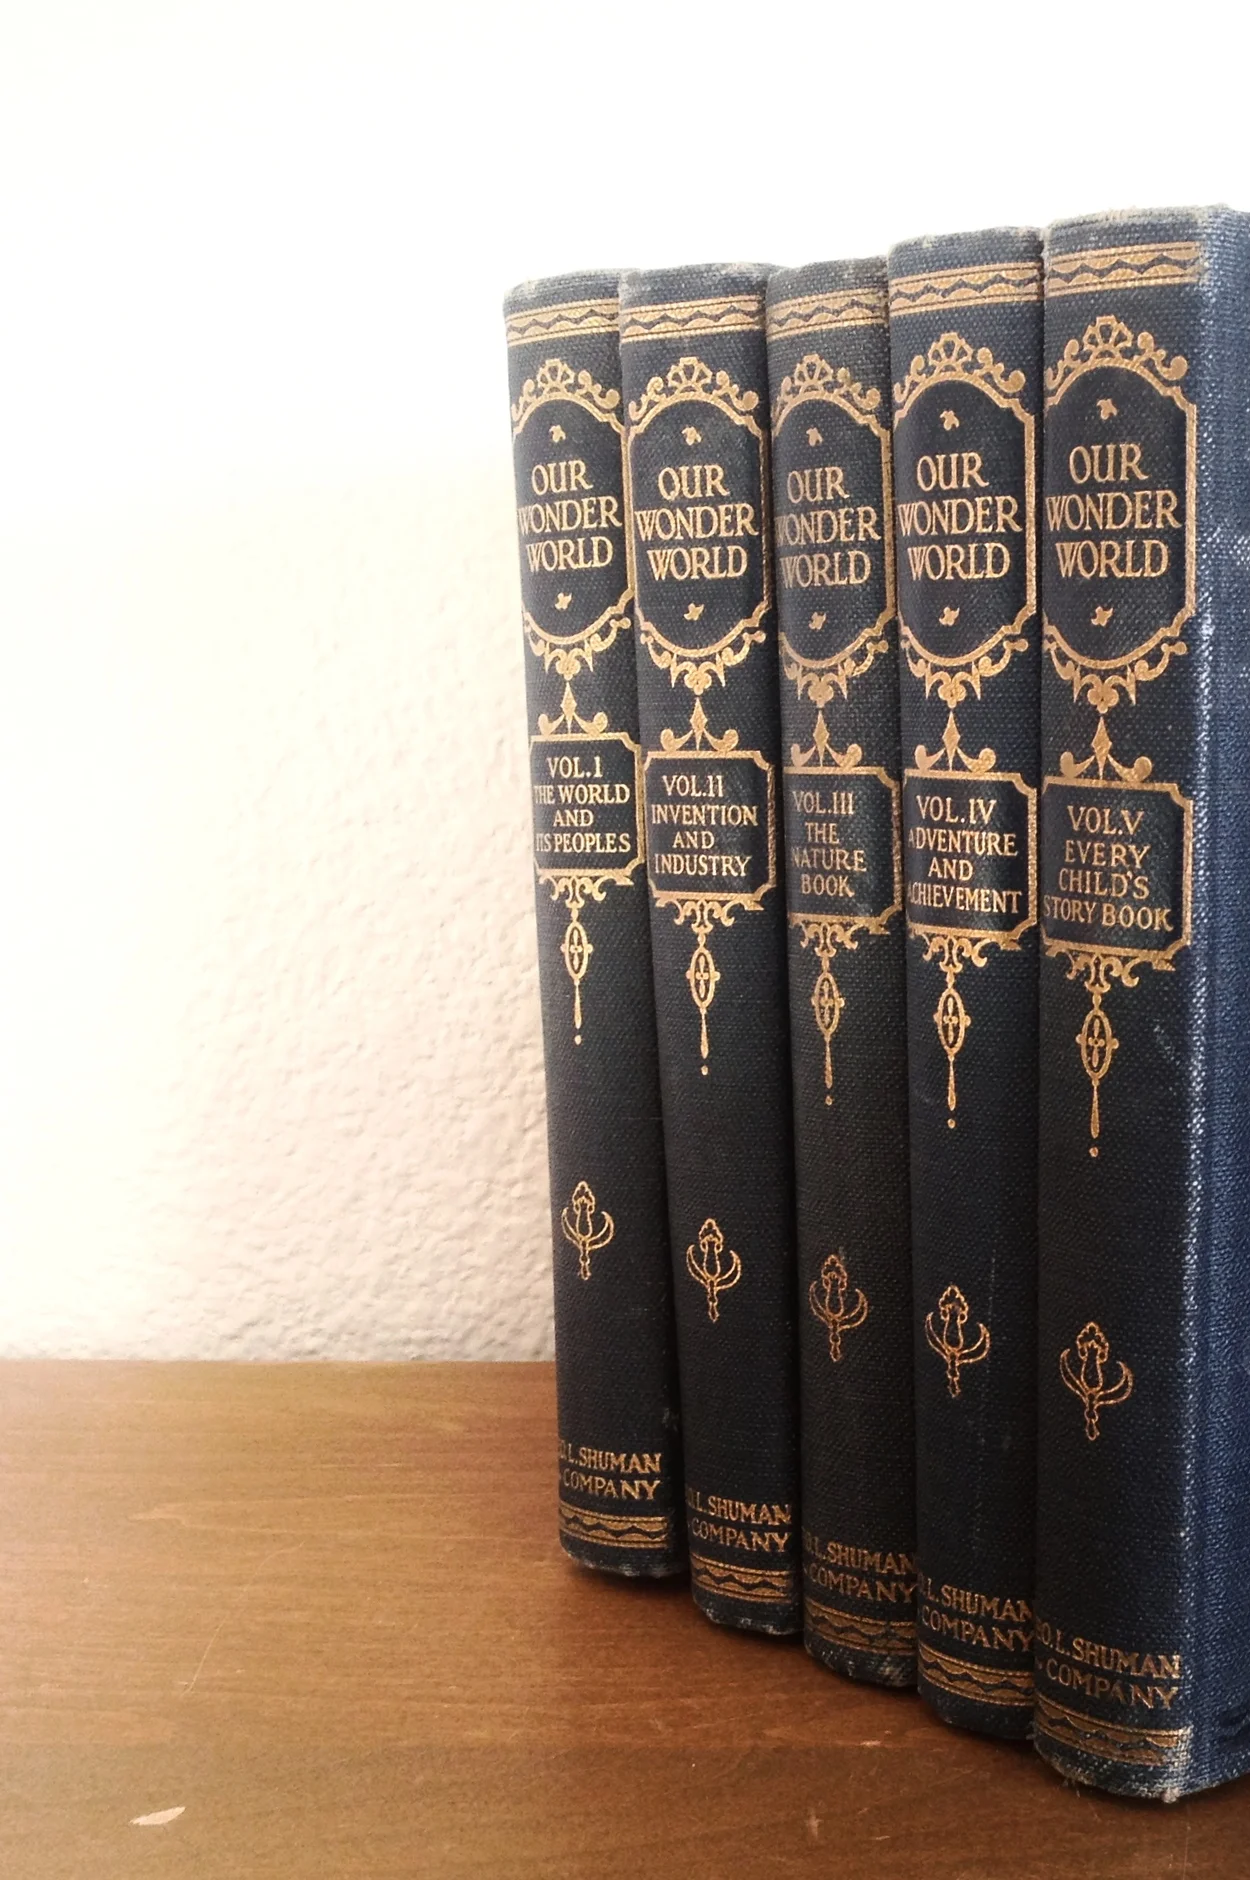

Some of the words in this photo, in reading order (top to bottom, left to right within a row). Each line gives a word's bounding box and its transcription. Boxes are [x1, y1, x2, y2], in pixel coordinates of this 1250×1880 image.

[531, 460, 594, 496] OUR
[916, 451, 989, 492] OUR
[1069, 443, 1149, 484] OUR
[657, 464, 731, 501] OUR
[787, 466, 850, 504] OUR
[517, 495, 623, 536] WONDER
[634, 503, 760, 542] WONDER
[774, 505, 882, 548] WONDER
[898, 495, 1023, 537] WONDER
[1045, 490, 1183, 531] WONDER
[525, 536, 614, 573] WORLD
[646, 545, 749, 581] WORLD
[779, 550, 872, 589] WORLD
[907, 542, 1011, 581] WORLD
[1055, 539, 1169, 580] WORLD
[534, 784, 555, 804] THE
[558, 783, 631, 805] WORLD
[553, 809, 594, 827] AND
[651, 804, 759, 827] INVENTION
[805, 822, 840, 845] THE
[554, 832, 632, 853] PEOPLES
[672, 831, 716, 849] AND
[908, 826, 1019, 857] ADVENTURE
[1064, 839, 1150, 869] EVERY
[654, 853, 753, 877] INDUSTRY
[791, 846, 867, 872] NATURE
[927, 856, 974, 881] AND
[801, 873, 855, 897] BOOK
[1059, 868, 1150, 900] CHILD'S
[1043, 894, 1097, 923] STORY
[1102, 902, 1174, 932] BOOK
[579, 1446, 662, 1474] SHUMAN
[563, 1467, 661, 1500] COMPANY
[708, 1495, 792, 1526] SHUMAN
[691, 1516, 793, 1552] COMPANY
[827, 1540, 917, 1576] SHUMAN
[809, 1562, 918, 1603] COMPANY
[940, 1583, 1033, 1622] SHUMAN
[921, 1604, 1035, 1653] COMPANY
[1072, 1636, 1182, 1679] SHUMAN
[1046, 1657, 1179, 1711] COMPANY
